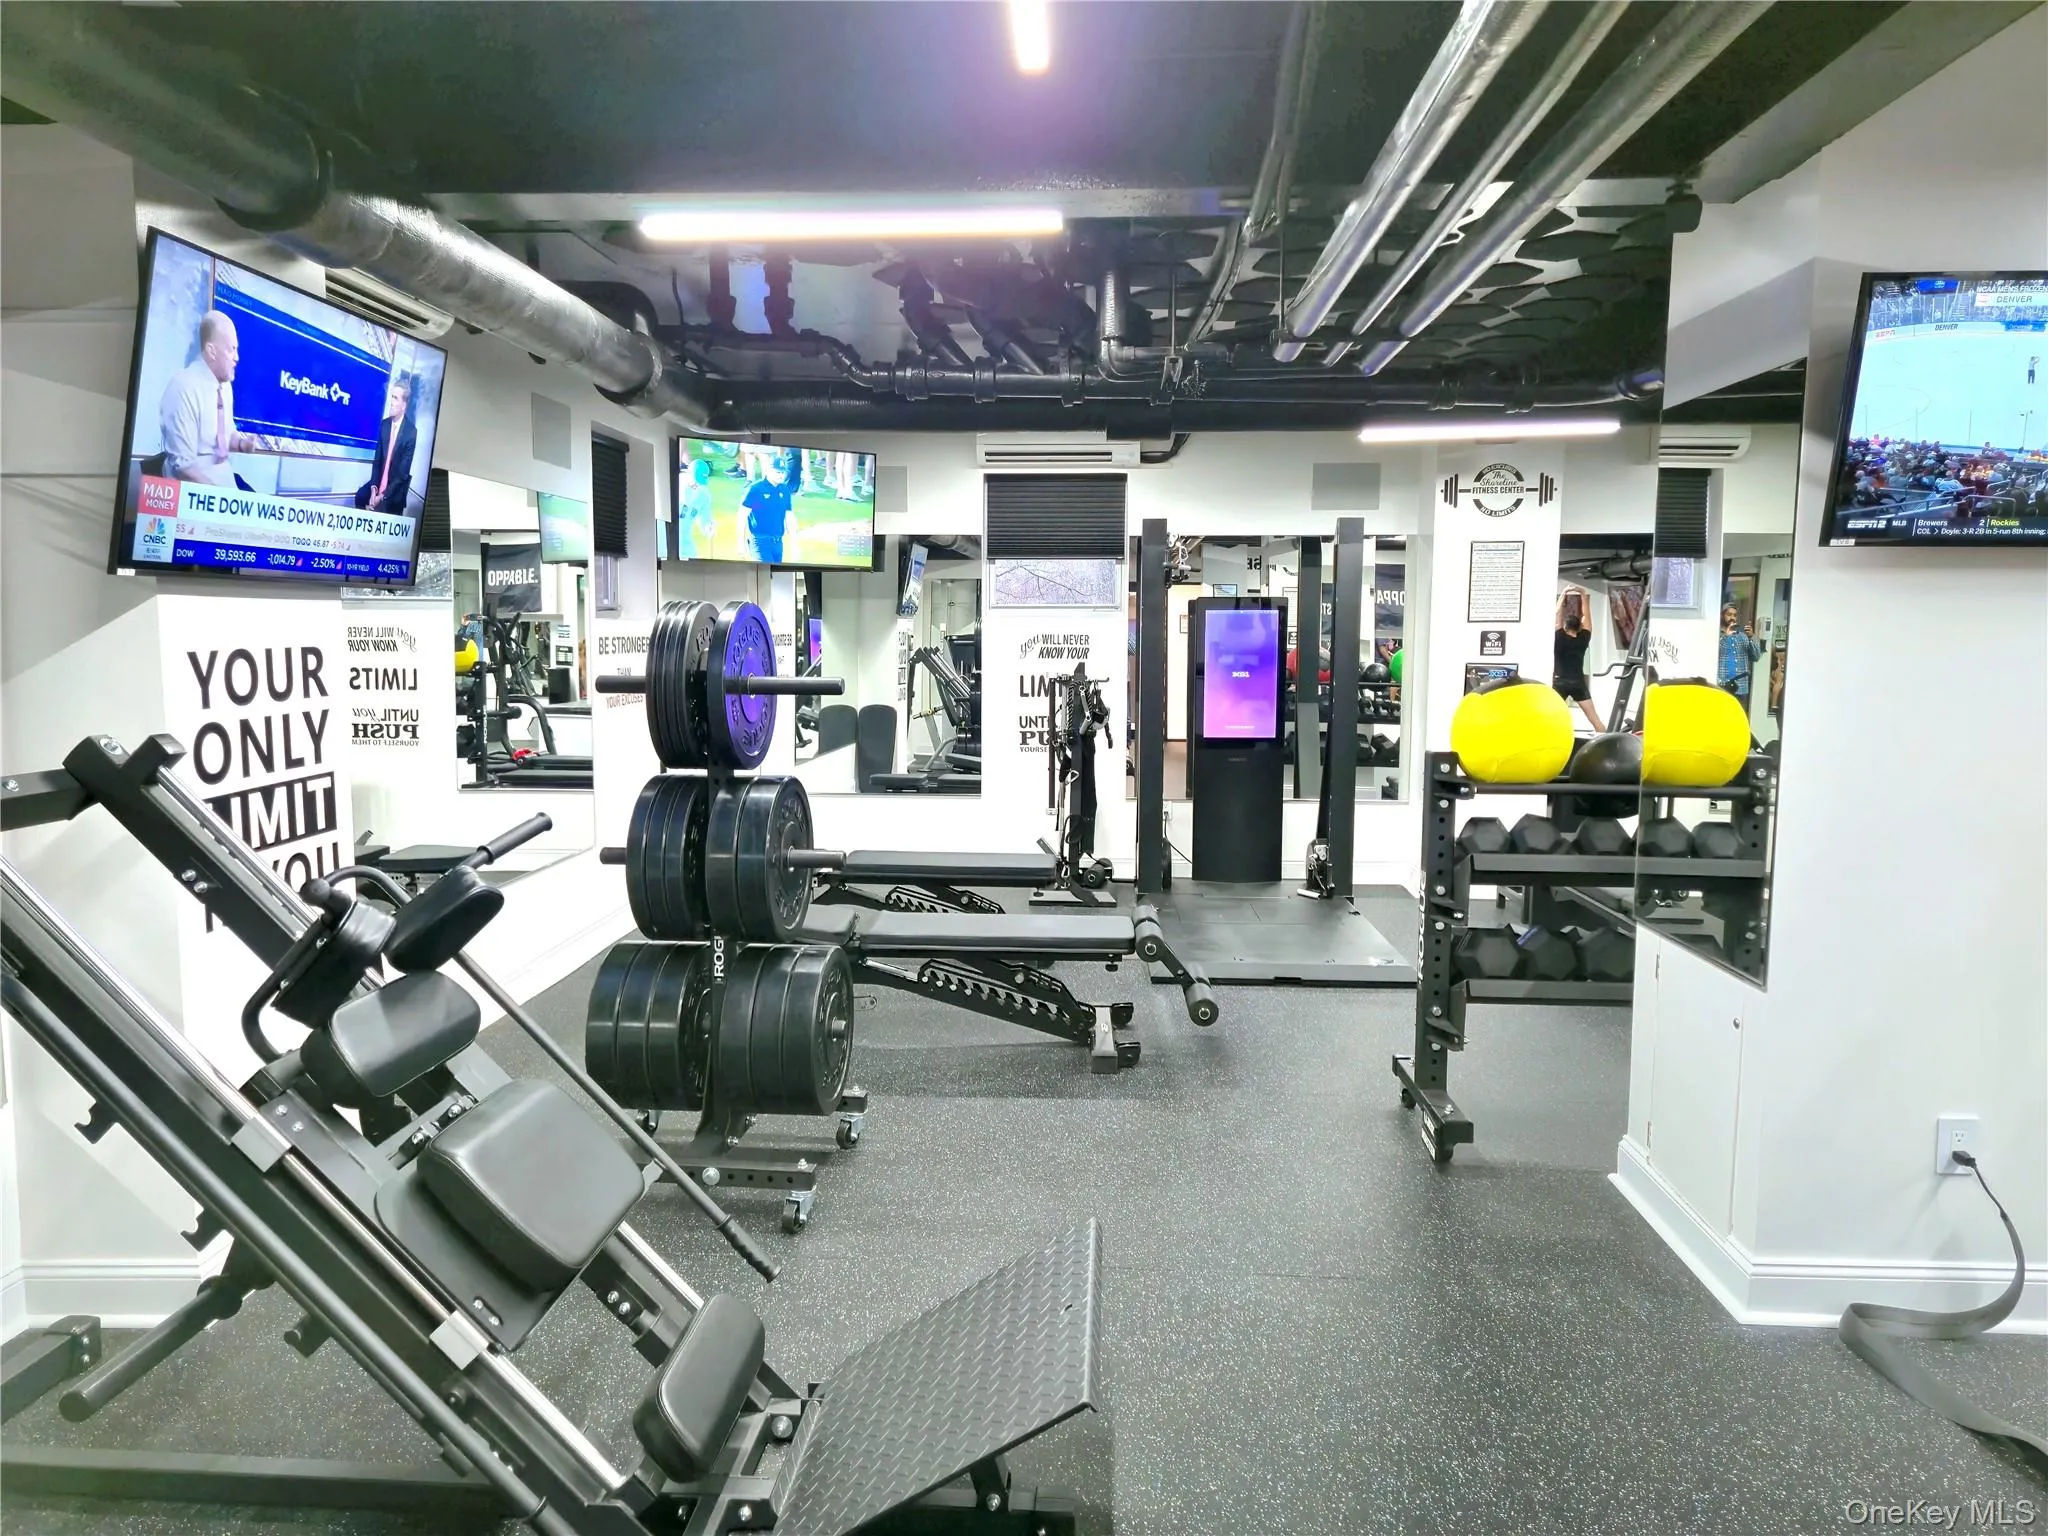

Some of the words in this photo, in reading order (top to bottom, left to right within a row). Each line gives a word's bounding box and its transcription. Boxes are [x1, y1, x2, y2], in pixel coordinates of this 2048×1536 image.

[1996, 295, 2033, 303] DENVER
[1935, 323, 1959, 331] DENVER
[280, 369, 329, 400] KeyBank
[1492, 471, 1505, 479] The
[144, 483, 174, 500] MAD
[1472, 486, 1499, 494] FITNESS
[145, 498, 176, 510] MONEY
[188, 492, 216, 512] THE
[219, 497, 254, 517] DOW
[257, 502, 284, 521] WAS
[287, 507, 326, 526] DOWN
[327, 513, 354, 531] 2,100
[355, 517, 373, 533] PTS
[375, 521, 387, 535] AT
[389, 523, 411, 538] LOW
[143, 534, 166, 544] CNBC
[176, 548, 195, 558] DOW
[214, 548, 257, 563] 39,593.66
[267, 553, 296, 566] -1,014.79
[311, 557, 336, 570] -2.50%
[378, 563, 400, 574] 4.425%
[598, 636, 610, 655] BE
[1020, 633, 1041, 659] you
[1041, 634, 1061, 646] WILL
[1062, 634, 1090, 646] NEVER
[1038, 647, 1065, 659] KNOW
[1066, 647, 1090, 659] YOUR
[187, 646, 329, 709] YOUR
[606, 694, 620, 709] YOUR
[193, 708, 329, 785] ONLY
[203, 776, 332, 850] IMIT
[713, 935, 724, 977] ROG
